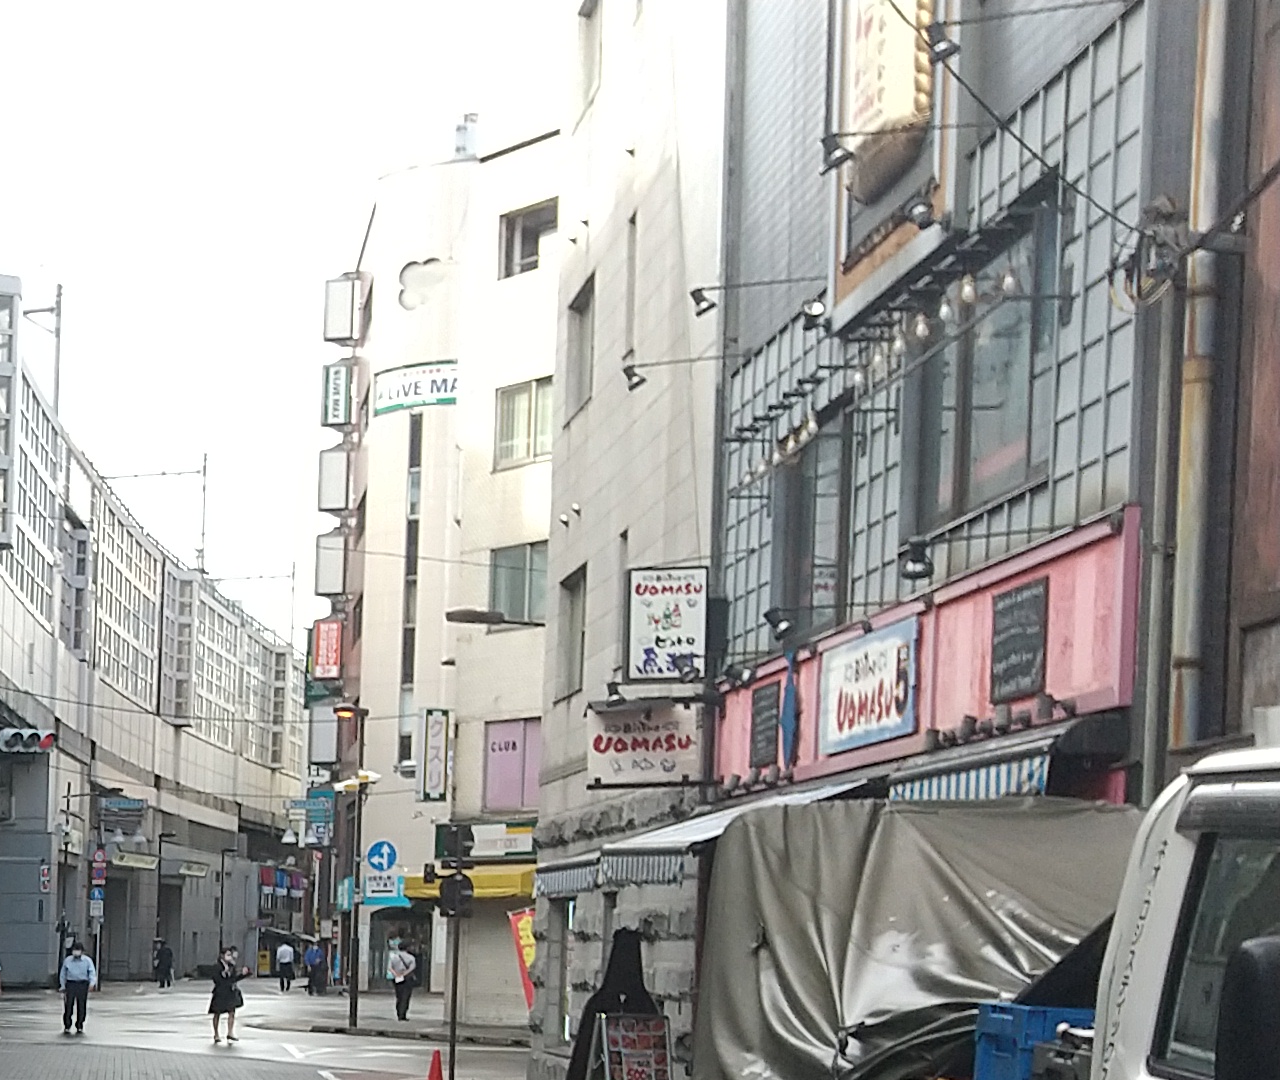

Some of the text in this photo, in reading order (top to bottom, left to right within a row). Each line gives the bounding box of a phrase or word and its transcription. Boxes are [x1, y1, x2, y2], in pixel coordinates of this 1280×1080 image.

[429, 719, 444, 790] クスリ
[490, 740, 518, 753] CLUB
[593, 732, 692, 755] UOMASU
